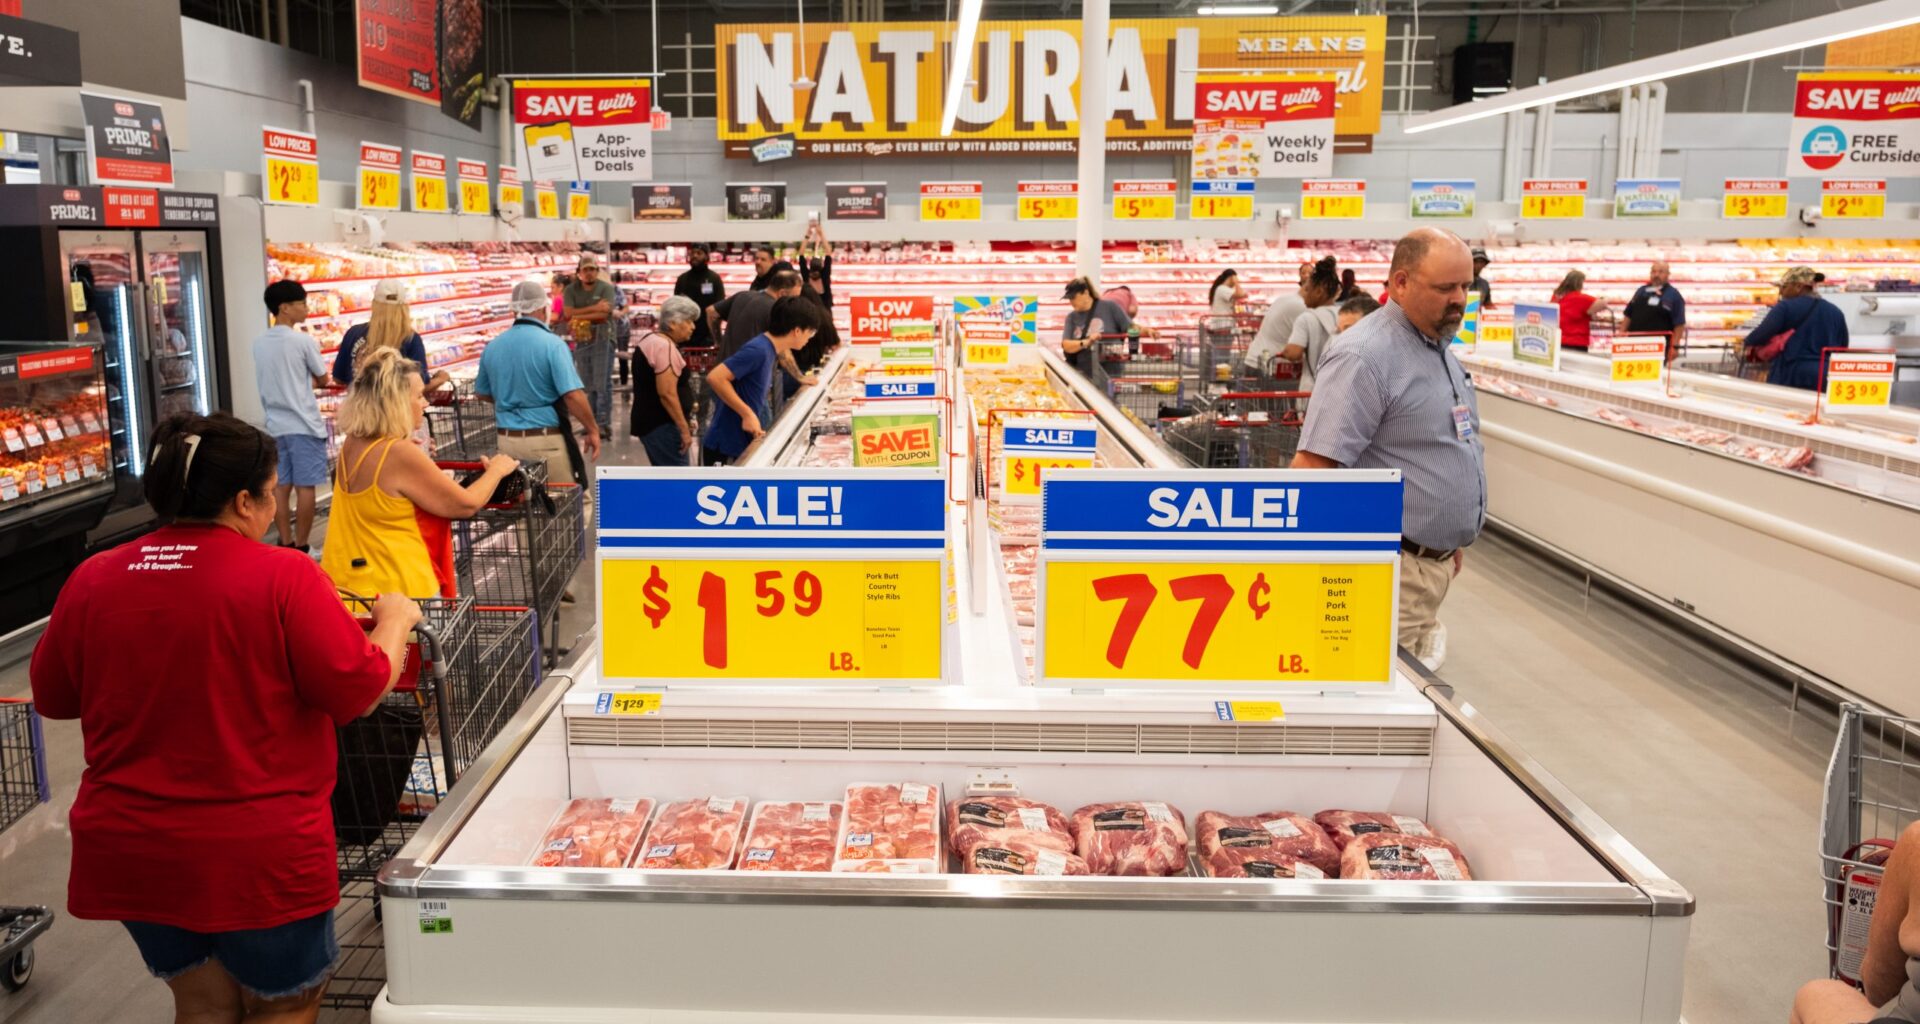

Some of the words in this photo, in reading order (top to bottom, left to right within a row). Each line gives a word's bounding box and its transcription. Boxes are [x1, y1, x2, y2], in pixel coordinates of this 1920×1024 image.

[1237, 37, 1366, 53] MEANS
[526, 95, 594, 116] SAVE
[598, 92, 637, 111] with
[1206, 90, 1277, 111] SAVE
[1282, 87, 1322, 106] with
[1807, 88, 1881, 110] SAVE
[104, 127, 152, 148] PRIME
[269, 134, 286, 149] LOW
[287, 137, 311, 153] PRICES
[596, 133, 631, 145] App-
[1268, 136, 1326, 150] Weekly
[1851, 135, 1898, 148] FREE
[582, 147, 646, 158] Exclusive
[812, 144, 831, 153] OUR
[833, 143, 863, 153] MEATS
[896, 142, 920, 152] EVER
[921, 142, 945, 152] MEET
[947, 142, 960, 152] UP
[962, 142, 986, 152] WITH
[988, 141, 1020, 152] ADDED
[1274, 151, 1318, 163] Deals
[595, 160, 633, 171] Deals
[947, 185, 975, 193] PRICES
[1024, 184, 1042, 192] LOW
[1044, 184, 1072, 192] PRICES
[1120, 183, 1139, 191] LOW
[1140, 183, 1169, 191] PRICES
[1530, 182, 1549, 190] LOW
[1550, 182, 1580, 190] PRICES
[1731, 182, 1751, 190] LOW
[1752, 182, 1780, 190] PRICES
[1829, 182, 1848, 190] LOW
[1849, 182, 1879, 190] PRICES
[50, 204, 90, 220] PRIME
[121, 208, 131, 219] 21
[868, 301, 913, 316] LOW
[1518, 324, 1549, 337] NATURAL
[1615, 344, 1632, 352] LOW
[1633, 344, 1659, 352] PRICES
[1835, 362, 1856, 371] LOW
[1856, 362, 1888, 371] PRICES
[881, 384, 918, 395] SALE!
[861, 428, 930, 455] SAVE!
[1025, 429, 1074, 445] SALE!
[864, 455, 887, 464] WITH
[890, 450, 930, 462] COUPON
[695, 485, 843, 526] SALE!
[1146, 487, 1300, 528] SALE!
[1322, 576, 1353, 585] Boston
[868, 583, 897, 591] Country
[1327, 589, 1346, 597] Butt
[866, 593, 884, 601] Style
[1326, 601, 1346, 609] Pork
[1324, 614, 1349, 622] Roast
[830, 652, 860, 671] LB.
[1278, 654, 1309, 673] LB.
[614, 699, 644, 711] $129
